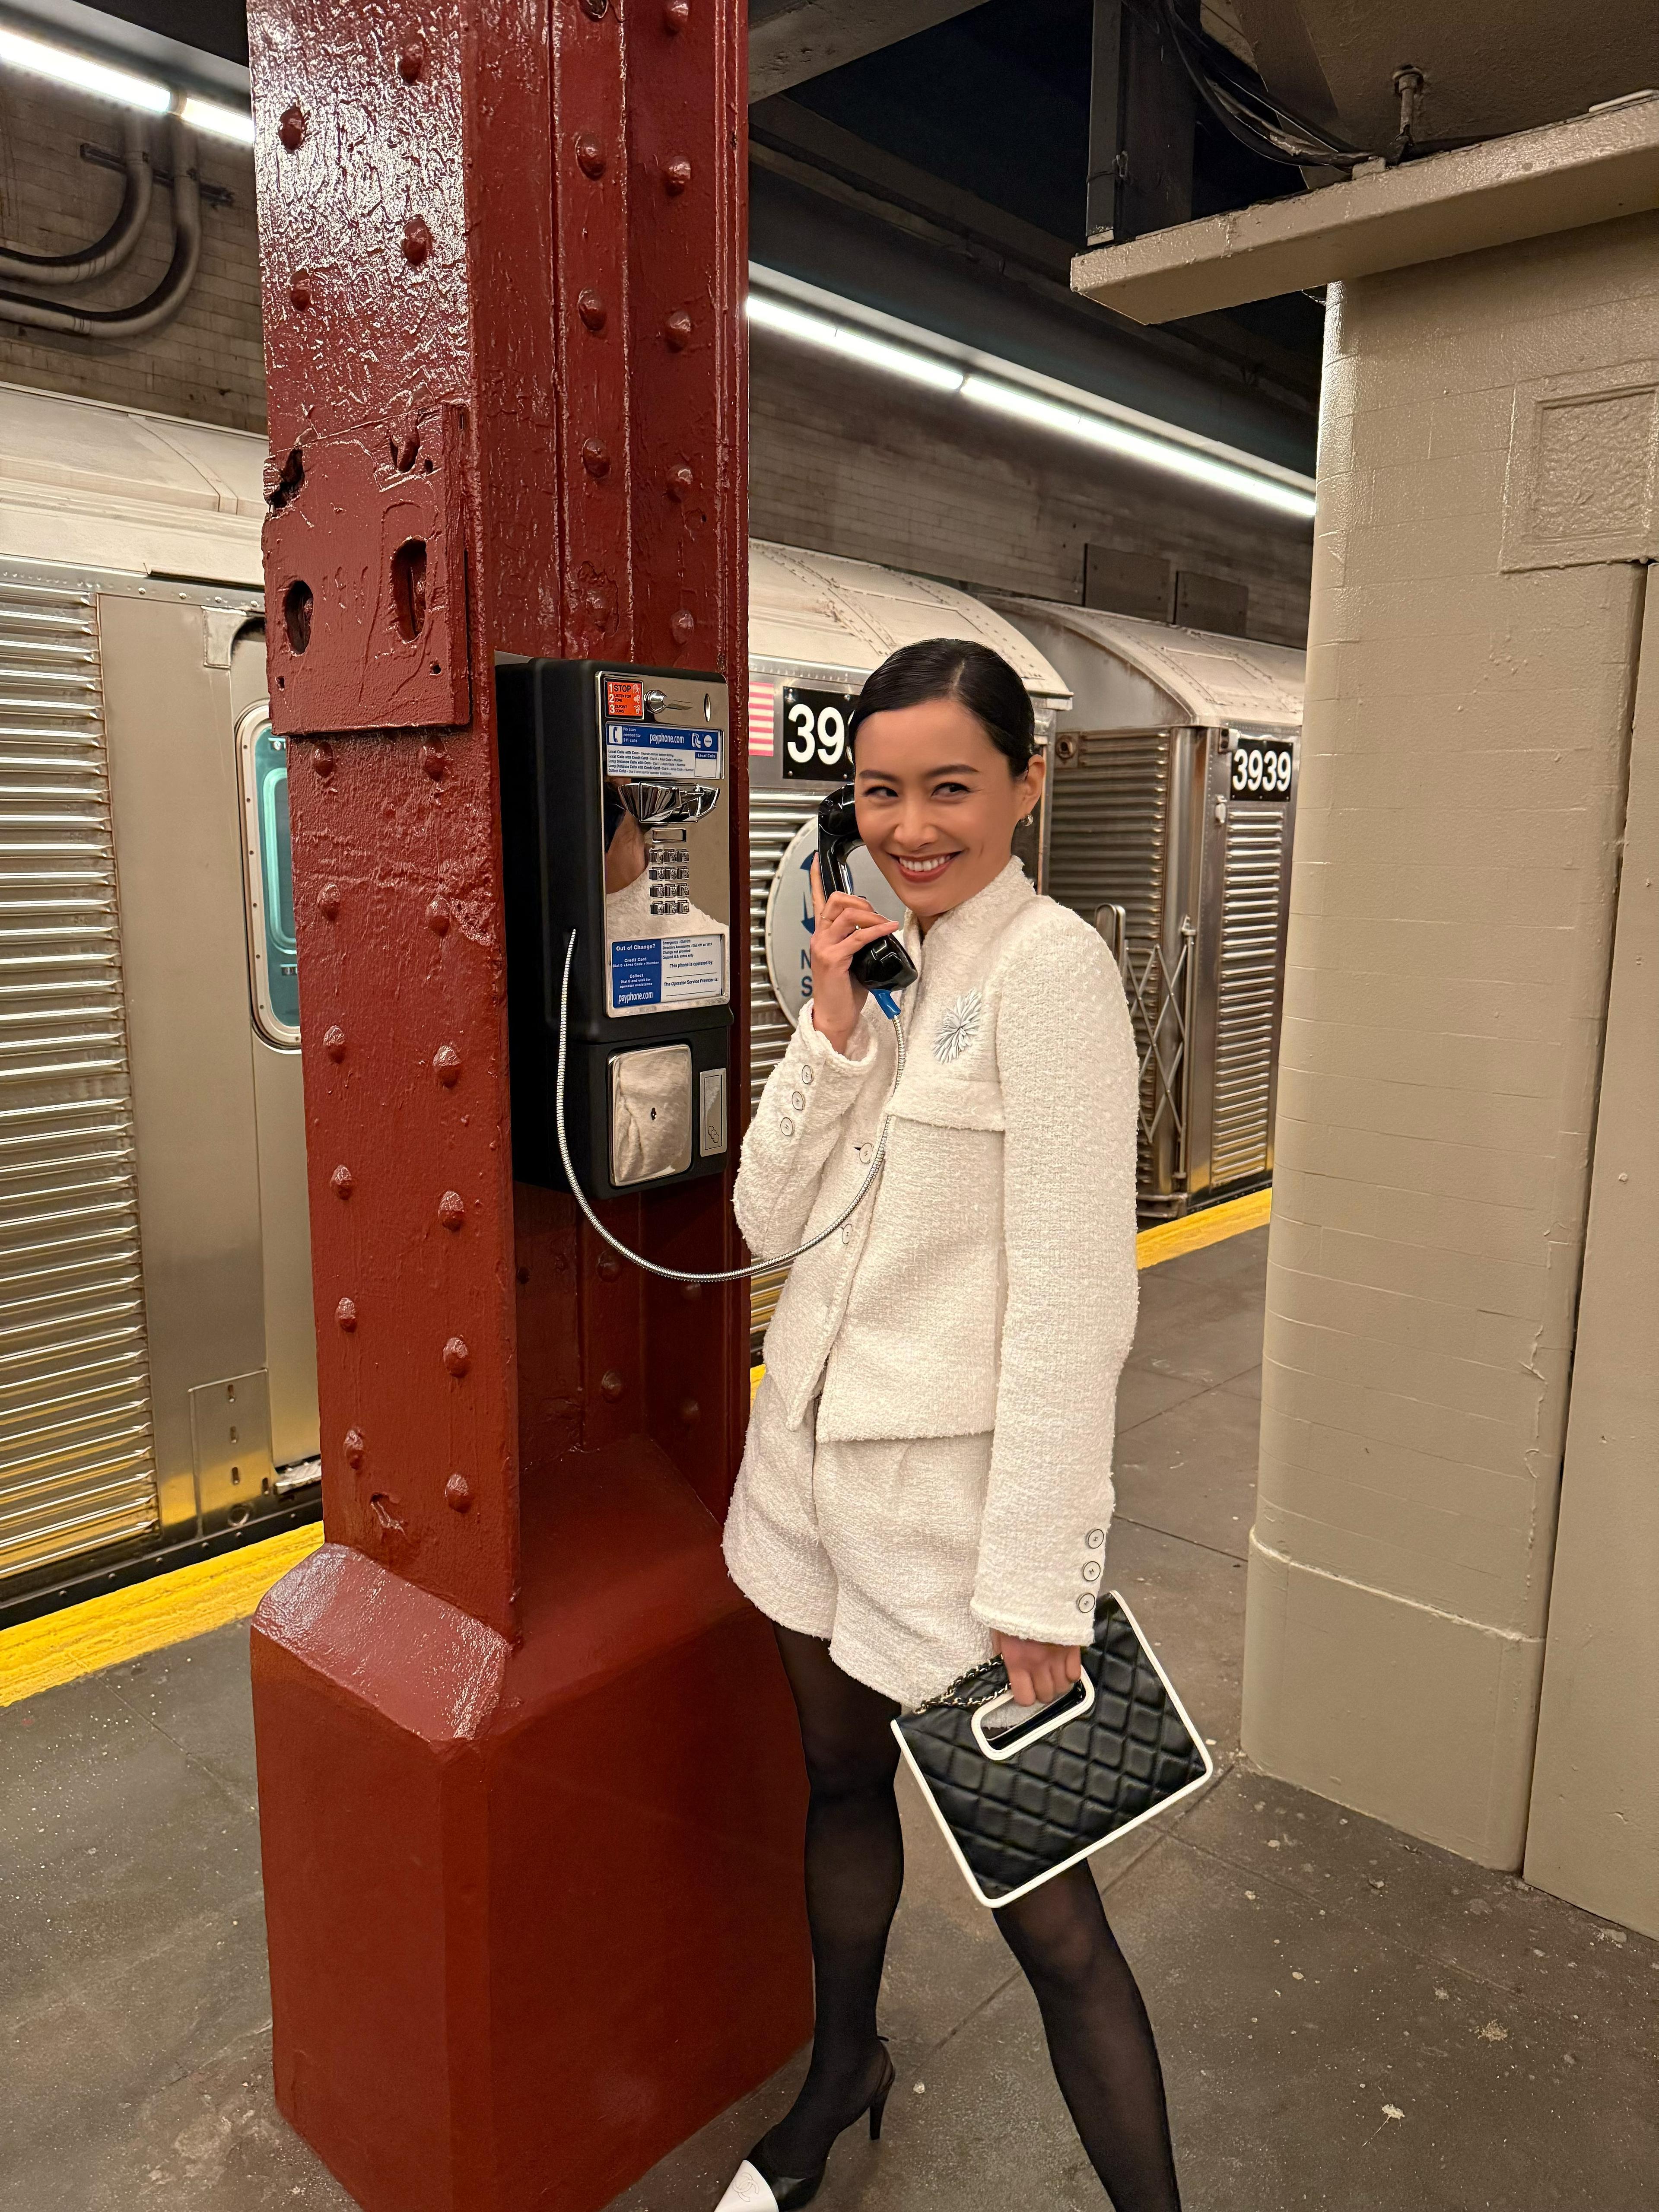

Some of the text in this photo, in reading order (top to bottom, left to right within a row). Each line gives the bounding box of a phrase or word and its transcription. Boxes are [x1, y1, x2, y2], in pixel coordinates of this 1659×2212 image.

[609, 683, 613, 693] 1
[609, 694, 614, 702] 2
[610, 704, 615, 713] 3
[650, 733, 684, 744] payphone.com
[787, 704, 855, 765] 39
[1233, 749, 1291, 791] 3939
[618, 992, 653, 1004] payphone.com
